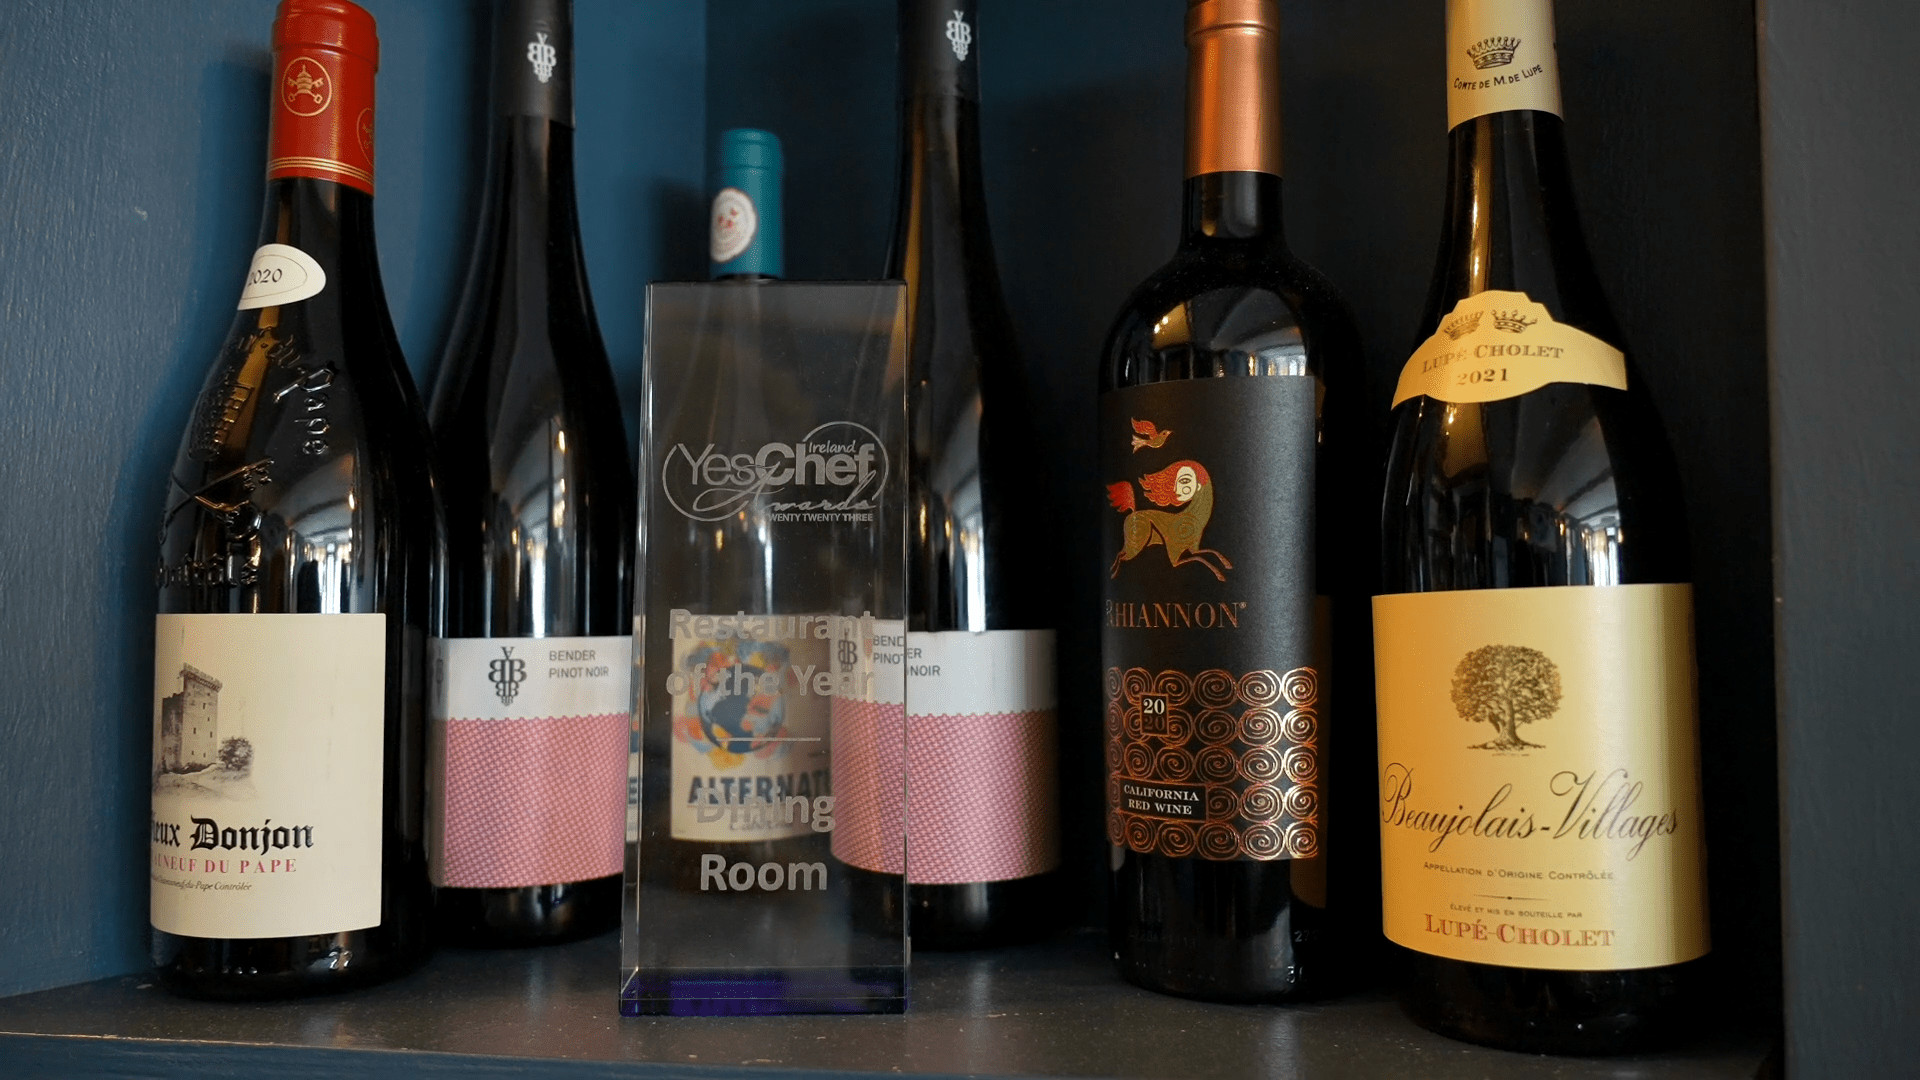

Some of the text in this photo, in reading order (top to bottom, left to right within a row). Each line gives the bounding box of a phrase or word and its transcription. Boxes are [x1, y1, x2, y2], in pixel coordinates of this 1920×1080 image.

[1454, 77, 1477, 90] COMTE
[1479, 80, 1490, 88] DE
[1508, 74, 1520, 84] DE
[1473, 344, 1564, 359] CHOLET
[1456, 368, 1508, 386] 2021
[808, 440, 856, 454] Ireland
[767, 513, 874, 521] WENTY TWENTY THREE
[669, 608, 876, 640] Restaurant
[549, 650, 596, 661] BENDER
[549, 666, 609, 678] PINOT NOIR
[910, 665, 941, 676] NOIR
[666, 662, 875, 696] of the Year
[1143, 698, 1165, 715] 20
[1123, 784, 1199, 801] CALIFORNIA
[697, 787, 836, 832] Dining
[1128, 799, 1192, 815] RED WINE
[1382, 762, 1678, 862] Beaujolais-Villages
[190, 814, 314, 856] Donjon
[204, 859, 230, 874] DU
[239, 858, 297, 874] PAPE
[700, 853, 828, 891] Room
[1423, 861, 1482, 876] APPELLATION
[1424, 913, 1615, 947] LUPÉ-CHOLET
